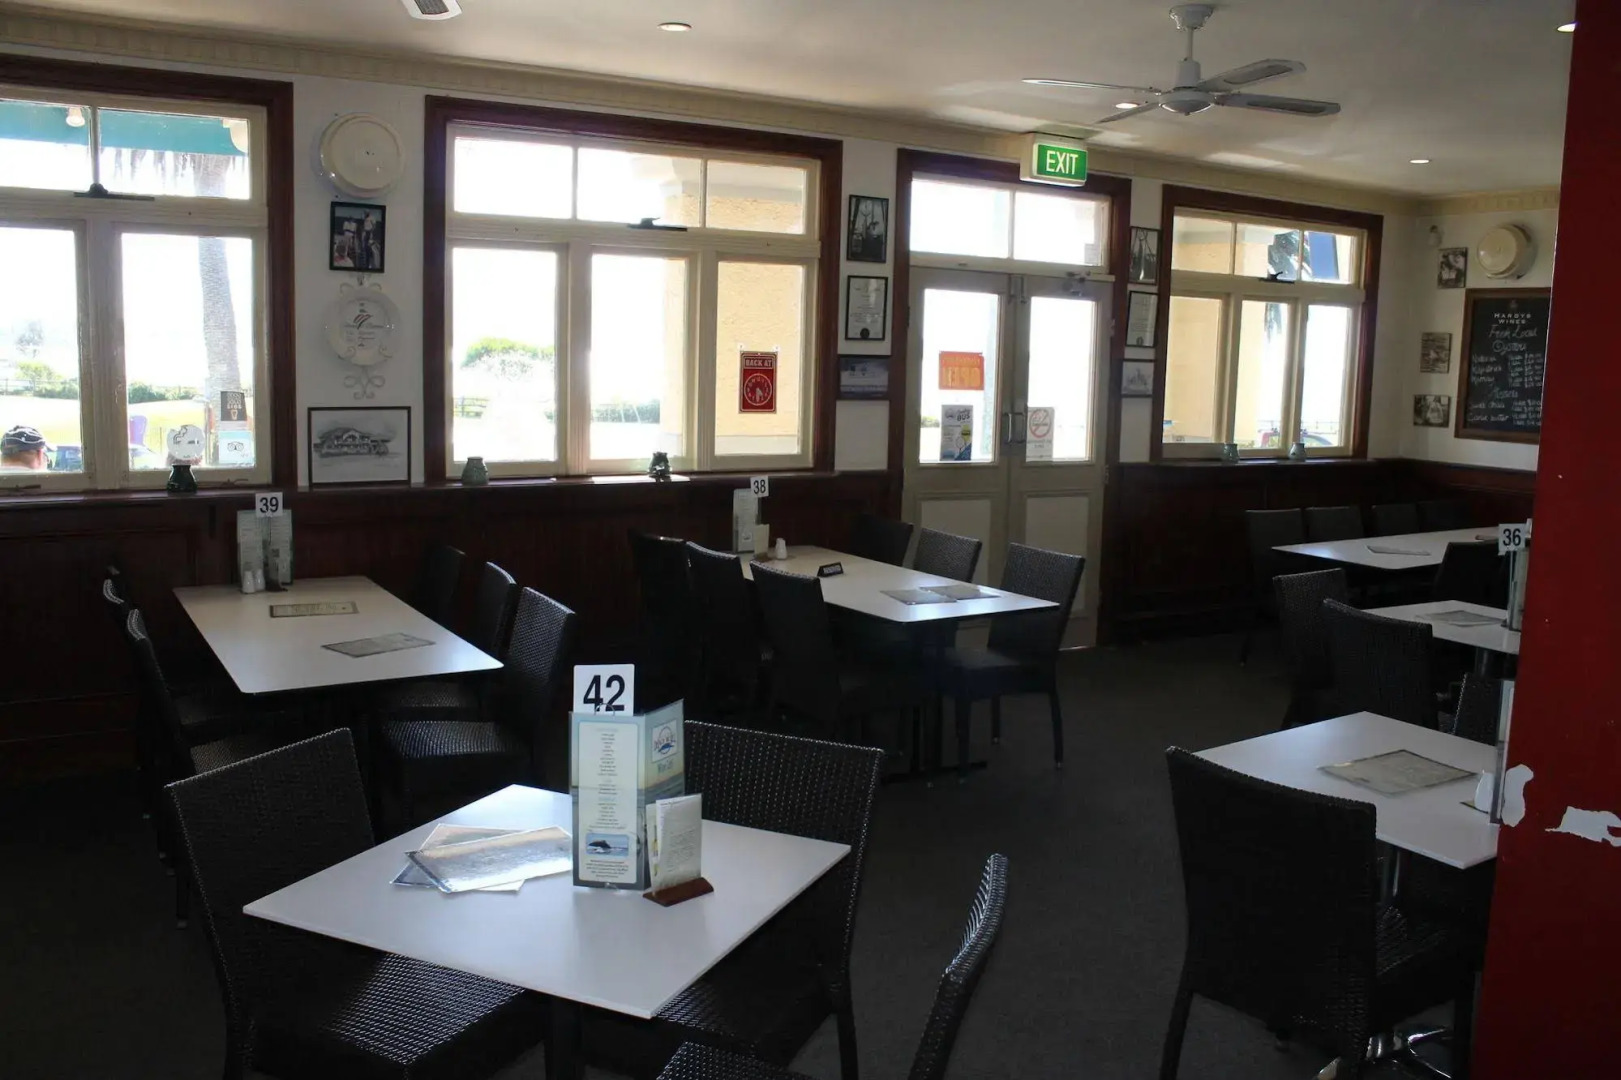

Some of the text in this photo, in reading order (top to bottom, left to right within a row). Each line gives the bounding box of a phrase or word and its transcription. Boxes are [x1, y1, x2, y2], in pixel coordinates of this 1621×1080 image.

[1046, 150, 1078, 175] EXIT
[745, 359, 773, 367] BACK AT
[753, 479, 767, 494] 38
[259, 496, 279, 513] 39
[1503, 528, 1521, 546] 36
[583, 674, 625, 712] 42
